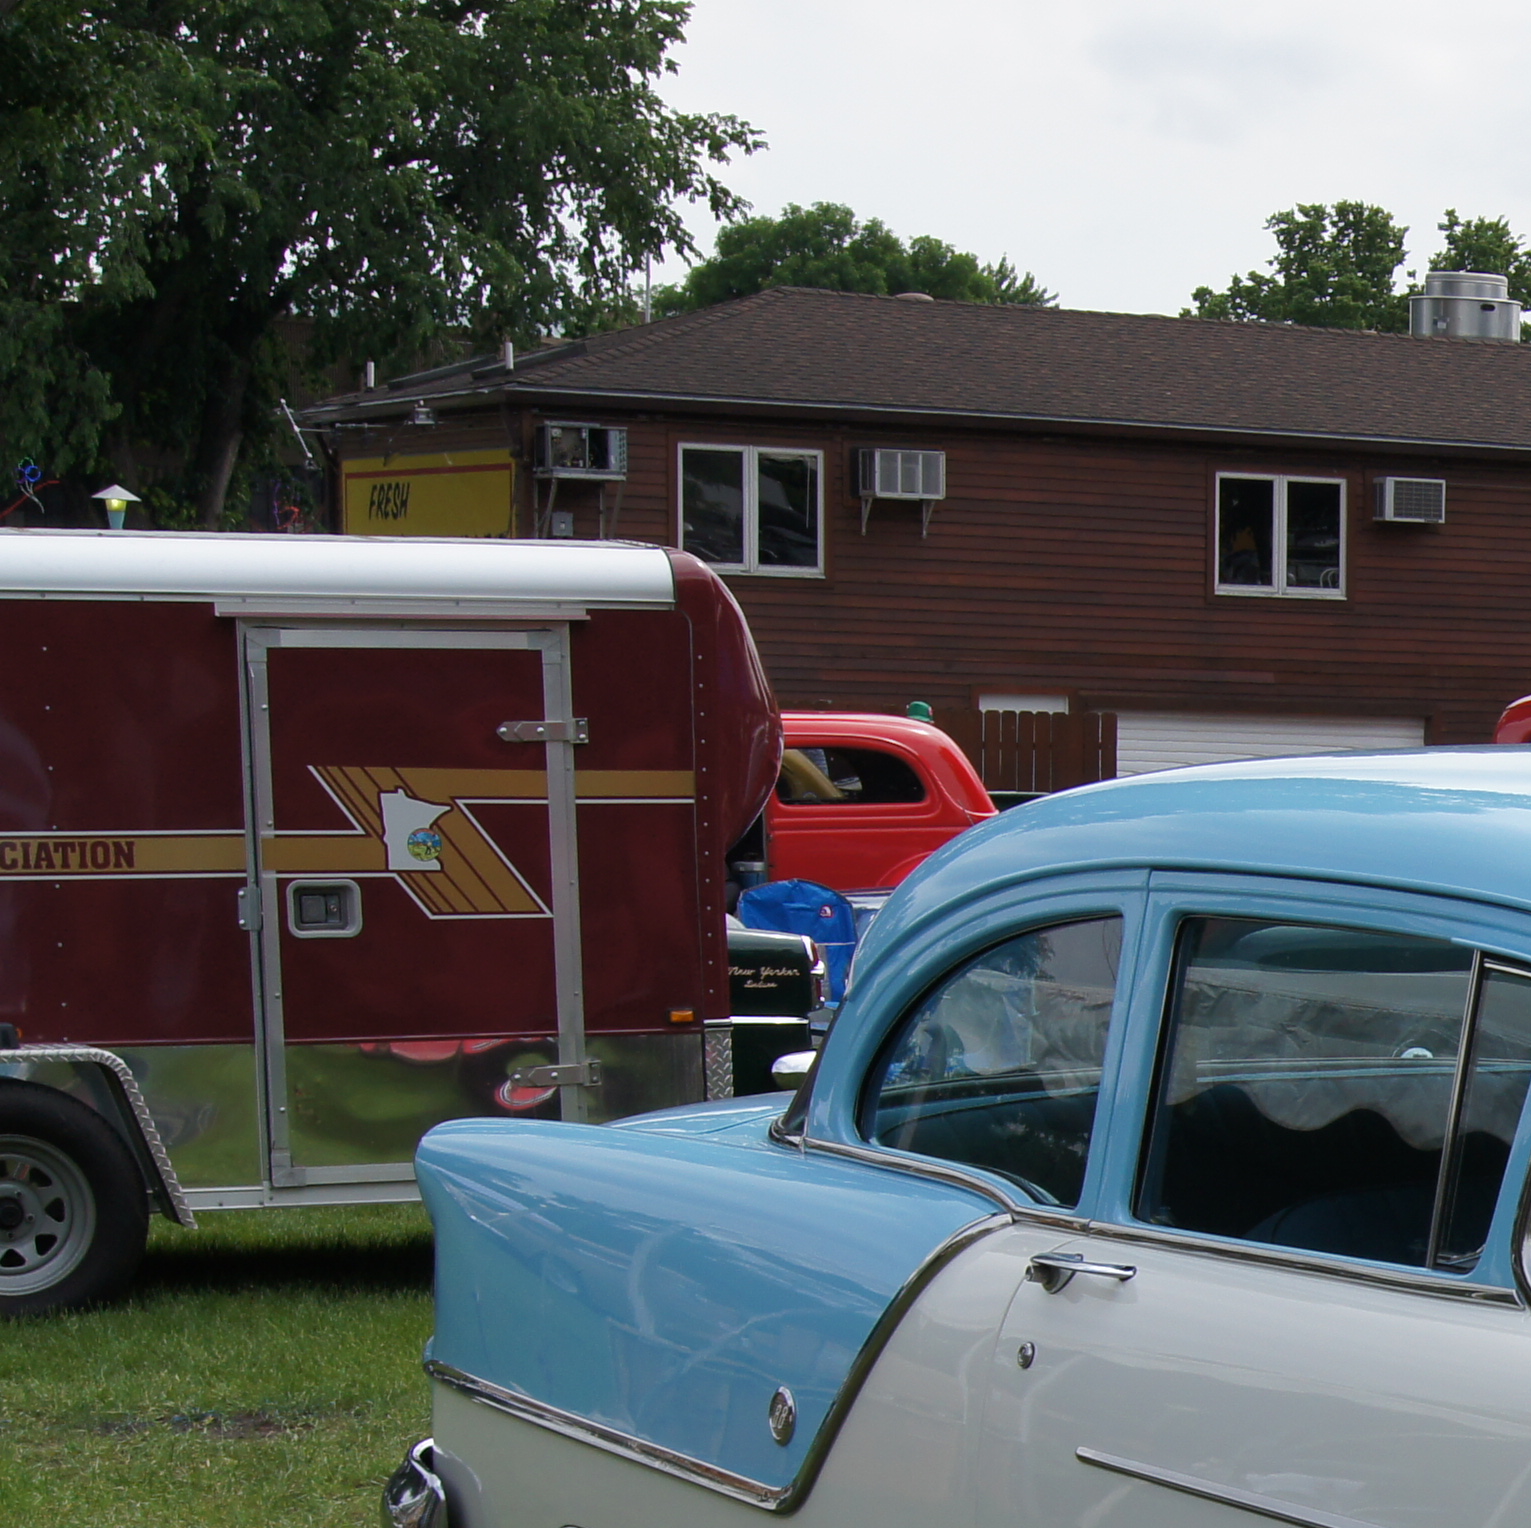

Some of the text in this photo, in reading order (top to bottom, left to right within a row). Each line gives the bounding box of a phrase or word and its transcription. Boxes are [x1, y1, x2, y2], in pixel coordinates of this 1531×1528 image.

[369, 482, 411, 520] FRESH
[0, 841, 135, 870] CIATION
[728, 966, 801, 980] New Yorker
[772, 1404, 789, 1429] 88
